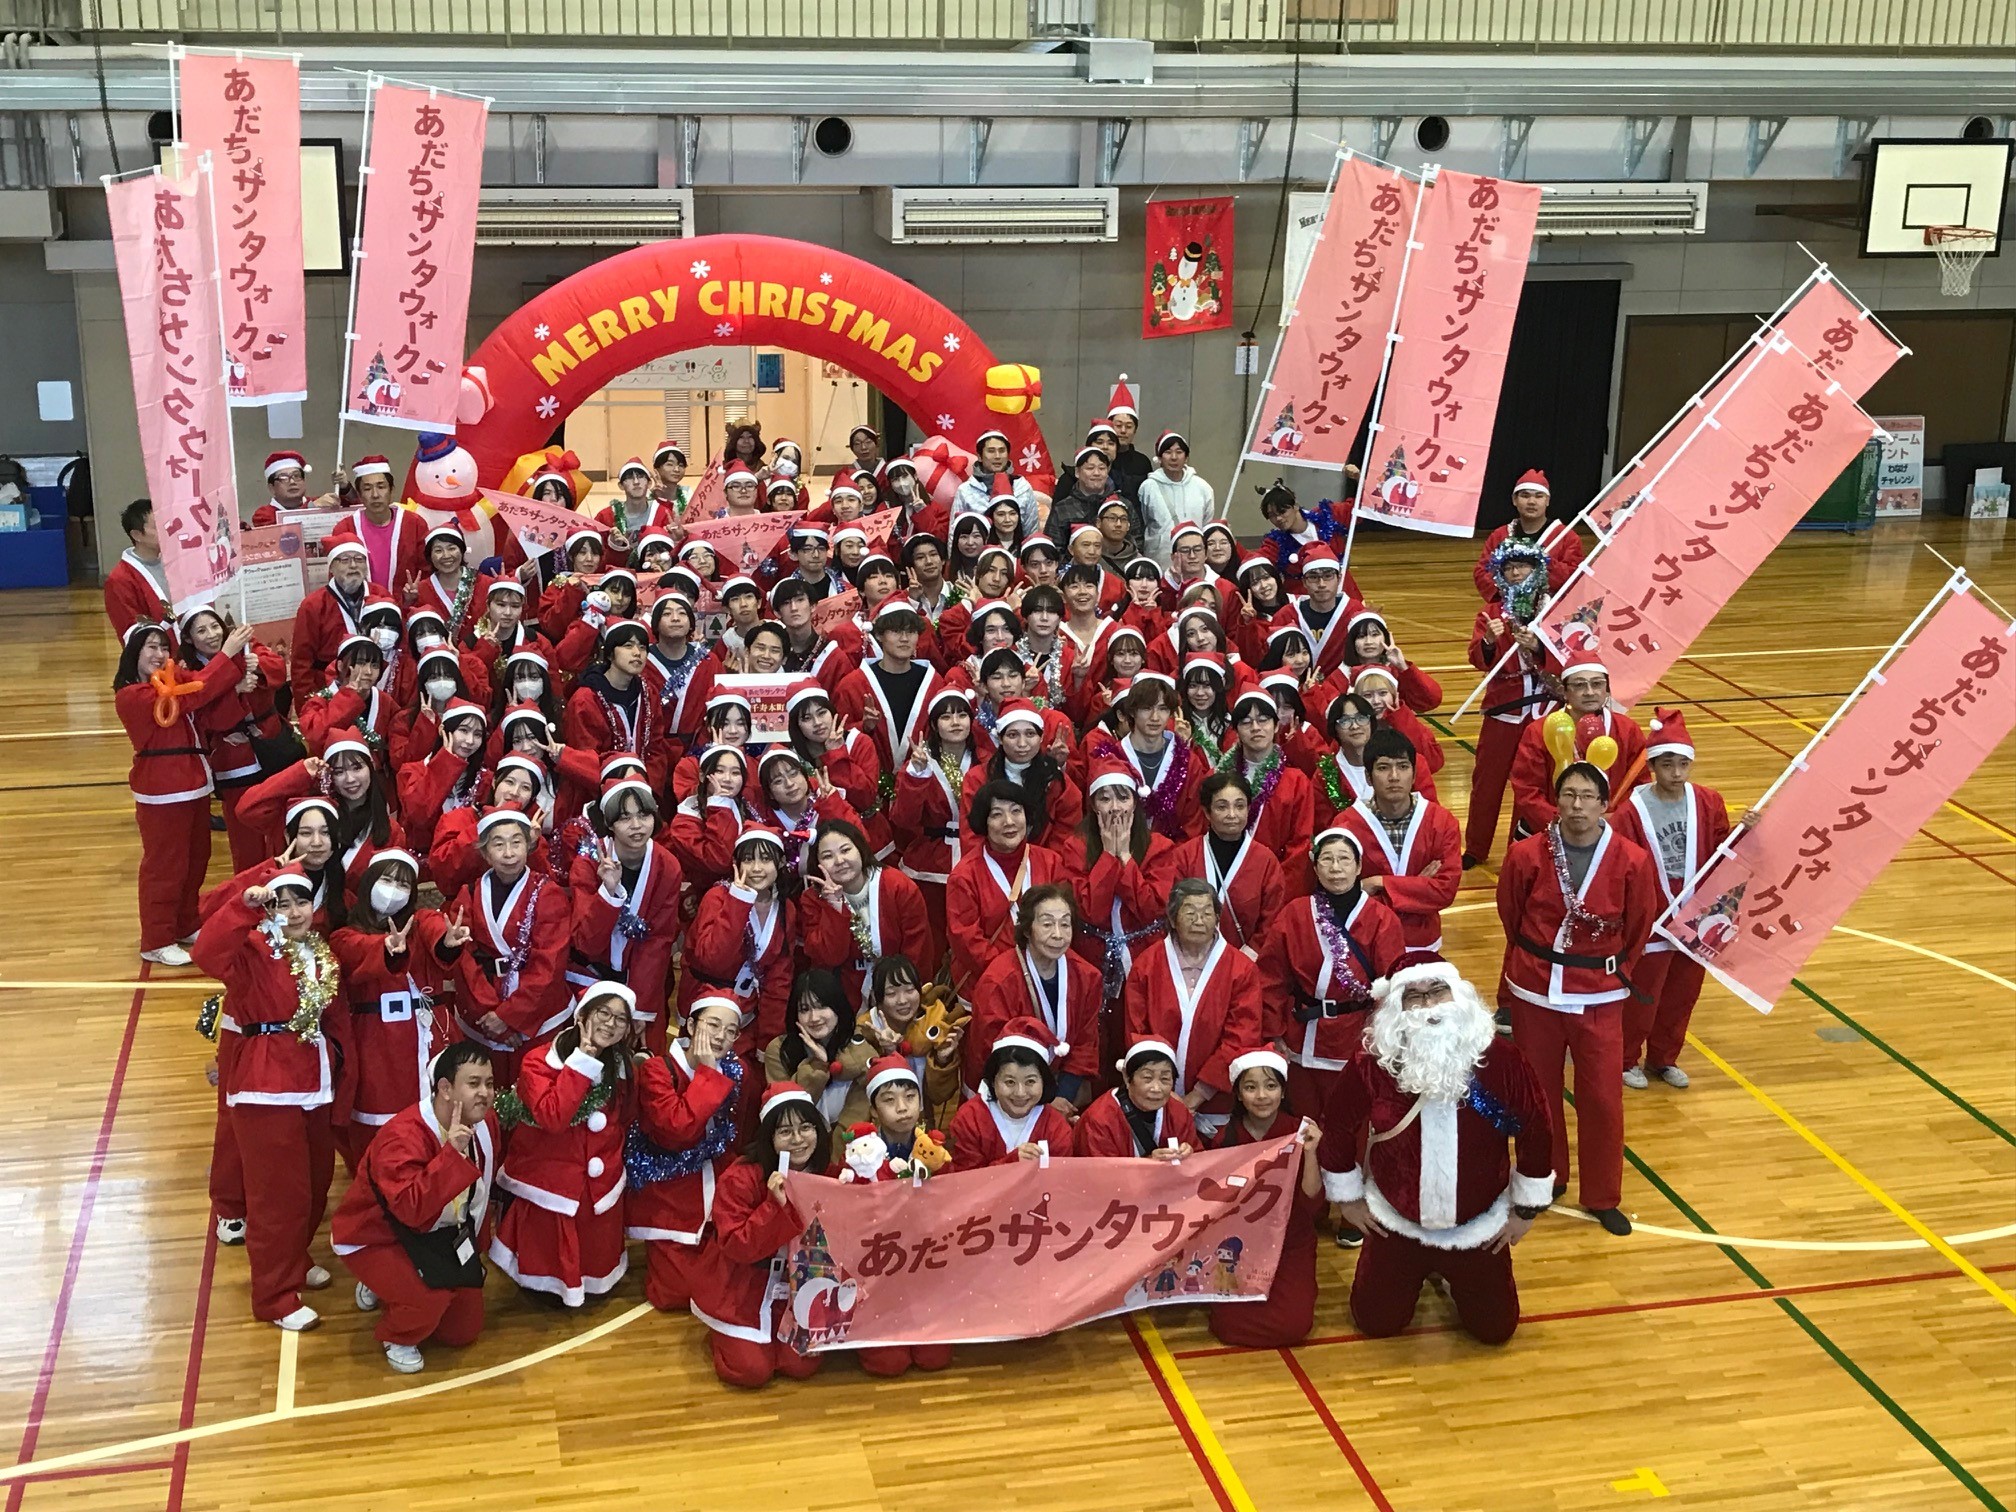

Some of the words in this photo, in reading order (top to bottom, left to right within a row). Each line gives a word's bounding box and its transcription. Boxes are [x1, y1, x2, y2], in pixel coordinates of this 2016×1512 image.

[223, 68, 272, 354] あだちサンタウォーク
[393, 104, 446, 374] あだちサンタウォーク
[530, 286, 681, 387] MERRY
[698, 279, 944, 385] CHRISTMAS
[1302, 182, 1402, 426] あだちサンタウォーク
[1414, 177, 1500, 471] あだちサンタウォーク
[701, 520, 793, 540] あだちサンタウォーク
[1608, 392, 1830, 633] あだちサンタウォーク
[1880, 475, 1915, 485] チャレンジ
[1747, 635, 2008, 918] あだちサンタウォーク
